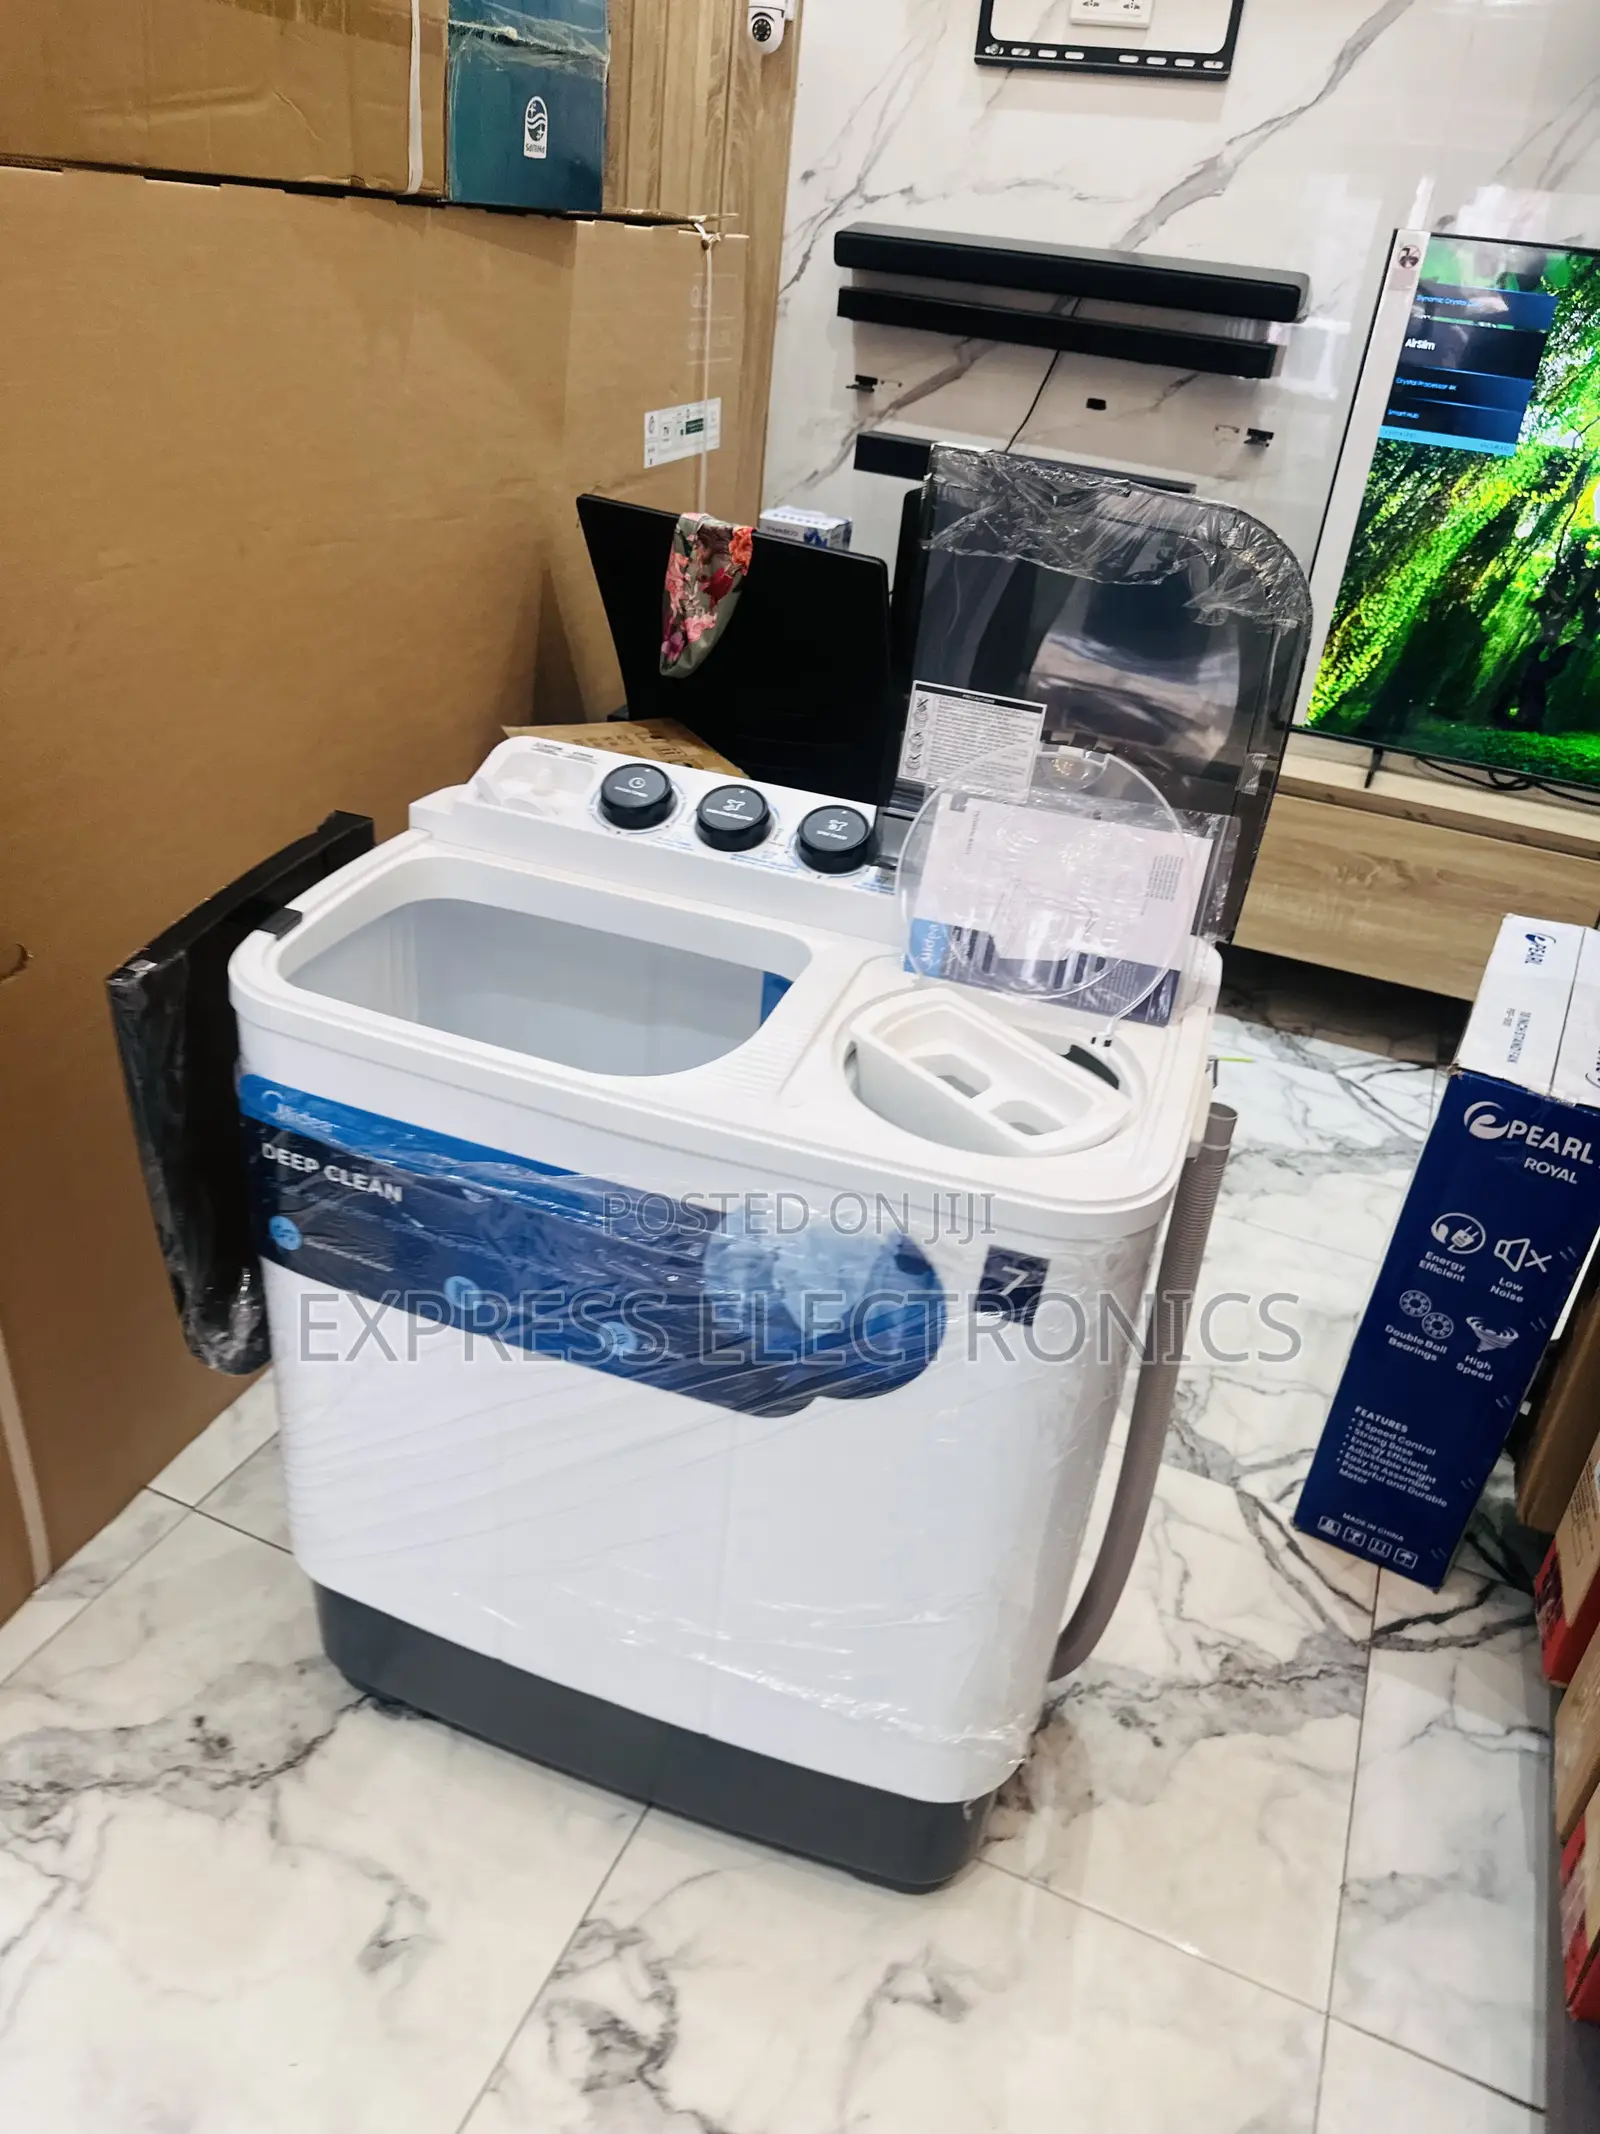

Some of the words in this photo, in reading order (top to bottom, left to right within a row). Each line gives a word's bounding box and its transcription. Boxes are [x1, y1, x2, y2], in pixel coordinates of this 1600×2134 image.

[1387, 408, 1406, 417] Smart
[1407, 411, 1420, 419] Hub
[1506, 1119, 1594, 1165] PEARL
[262, 1142, 320, 1173] DEEP
[324, 1164, 403, 1204] CLEAN
[1523, 1157, 1578, 1185] ROYAL
[1418, 1260, 1466, 1283] Efficient
[1424, 1251, 1466, 1272] Energy
[999, 1266, 1029, 1296] 7
[1490, 1285, 1524, 1303] Noise
[1499, 1277, 1523, 1292] Low
[1384, 1324, 1425, 1345] Double
[1425, 1339, 1448, 1354] Ball
[1388, 1337, 1438, 1361] Bearings
[1456, 1362, 1494, 1381] Speed
[1464, 1355, 1492, 1371] High
[1354, 1405, 1409, 1433] FEATURES
[1354, 1427, 1388, 1448] Strong
[1388, 1441, 1413, 1456] Base
[1365, 1422, 1397, 1441] Speed
[1397, 1436, 1437, 1456] Control
[1348, 1444, 1402, 1470] Adjustable
[1402, 1466, 1437, 1484] Height
[1350, 1435, 1385, 1457] Energy
[1386, 1450, 1428, 1472] Efficient
[1339, 1467, 1368, 1484] Motor
[1341, 1459, 1386, 1482] Powerful
[1386, 1479, 1407, 1491] and
[1407, 1486, 1447, 1507] Durable
[1344, 1451, 1367, 1467] Easy
[1369, 1462, 1380, 1471] to
[1380, 1467, 1431, 1491] Assemble
[1342, 1512, 1366, 1527] MADE
[1367, 1523, 1377, 1531] IN
[1377, 1527, 1404, 1542] CHINA
